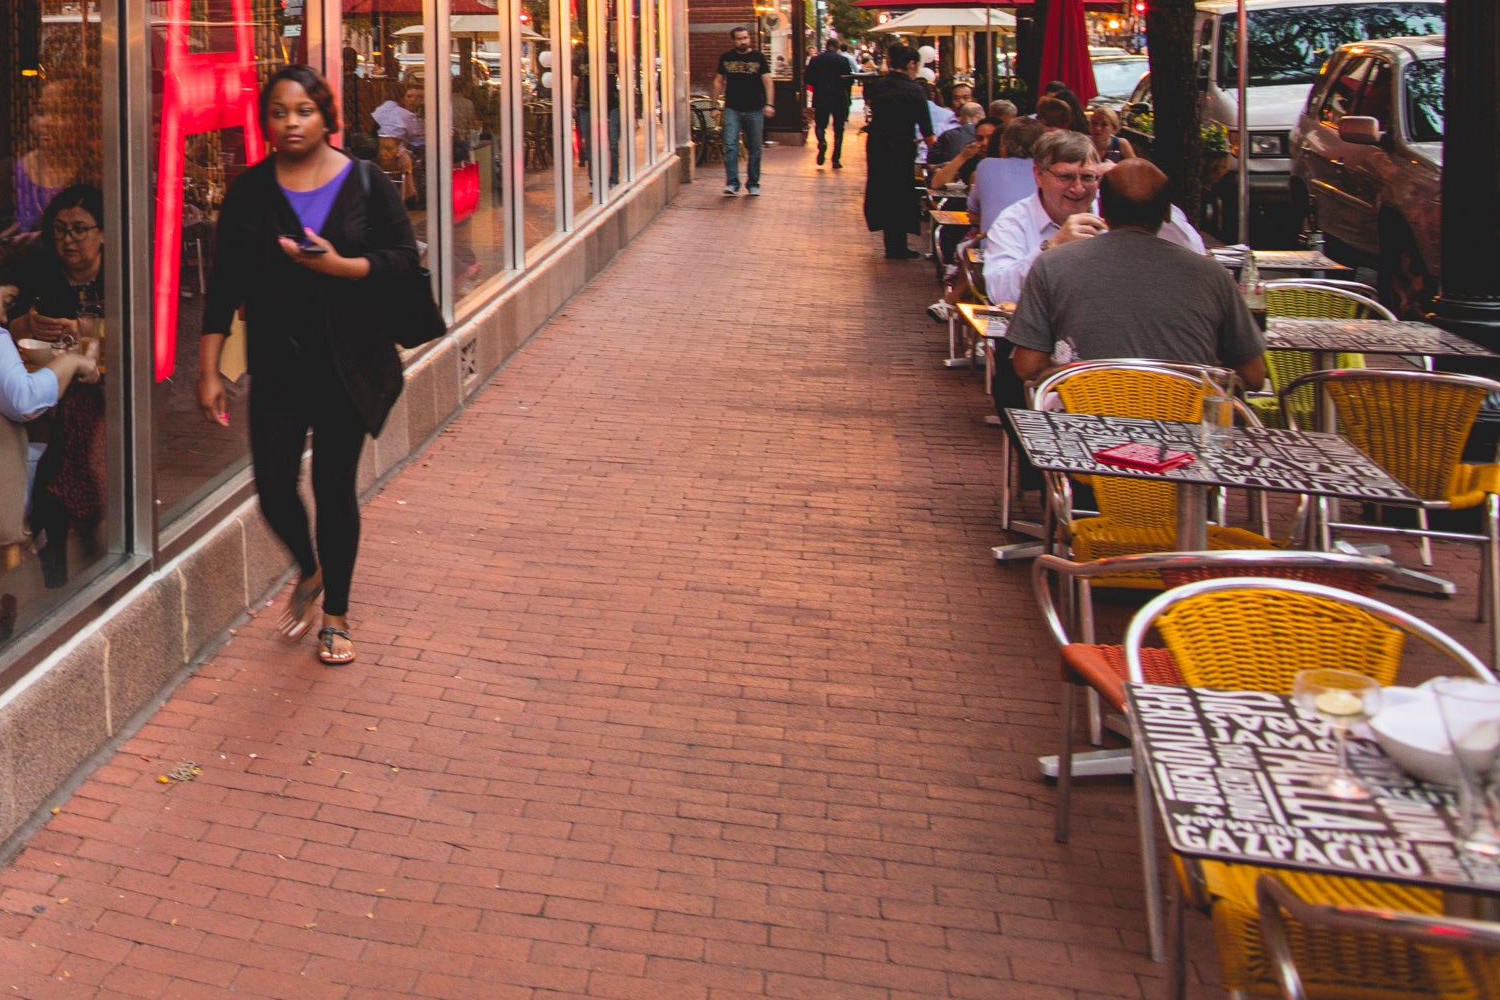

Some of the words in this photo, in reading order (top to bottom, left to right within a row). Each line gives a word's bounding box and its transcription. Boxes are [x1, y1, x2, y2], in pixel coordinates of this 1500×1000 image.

[1199, 452, 1387, 477] BRAVAS
[1219, 473, 1414, 498] TORTILLA
[1130, 683, 1219, 767] APERITIVO
[1257, 747, 1387, 831] PAELLA
[1172, 812, 1308, 839] QUEMADA
[1175, 825, 1423, 876] GAZPACHO
